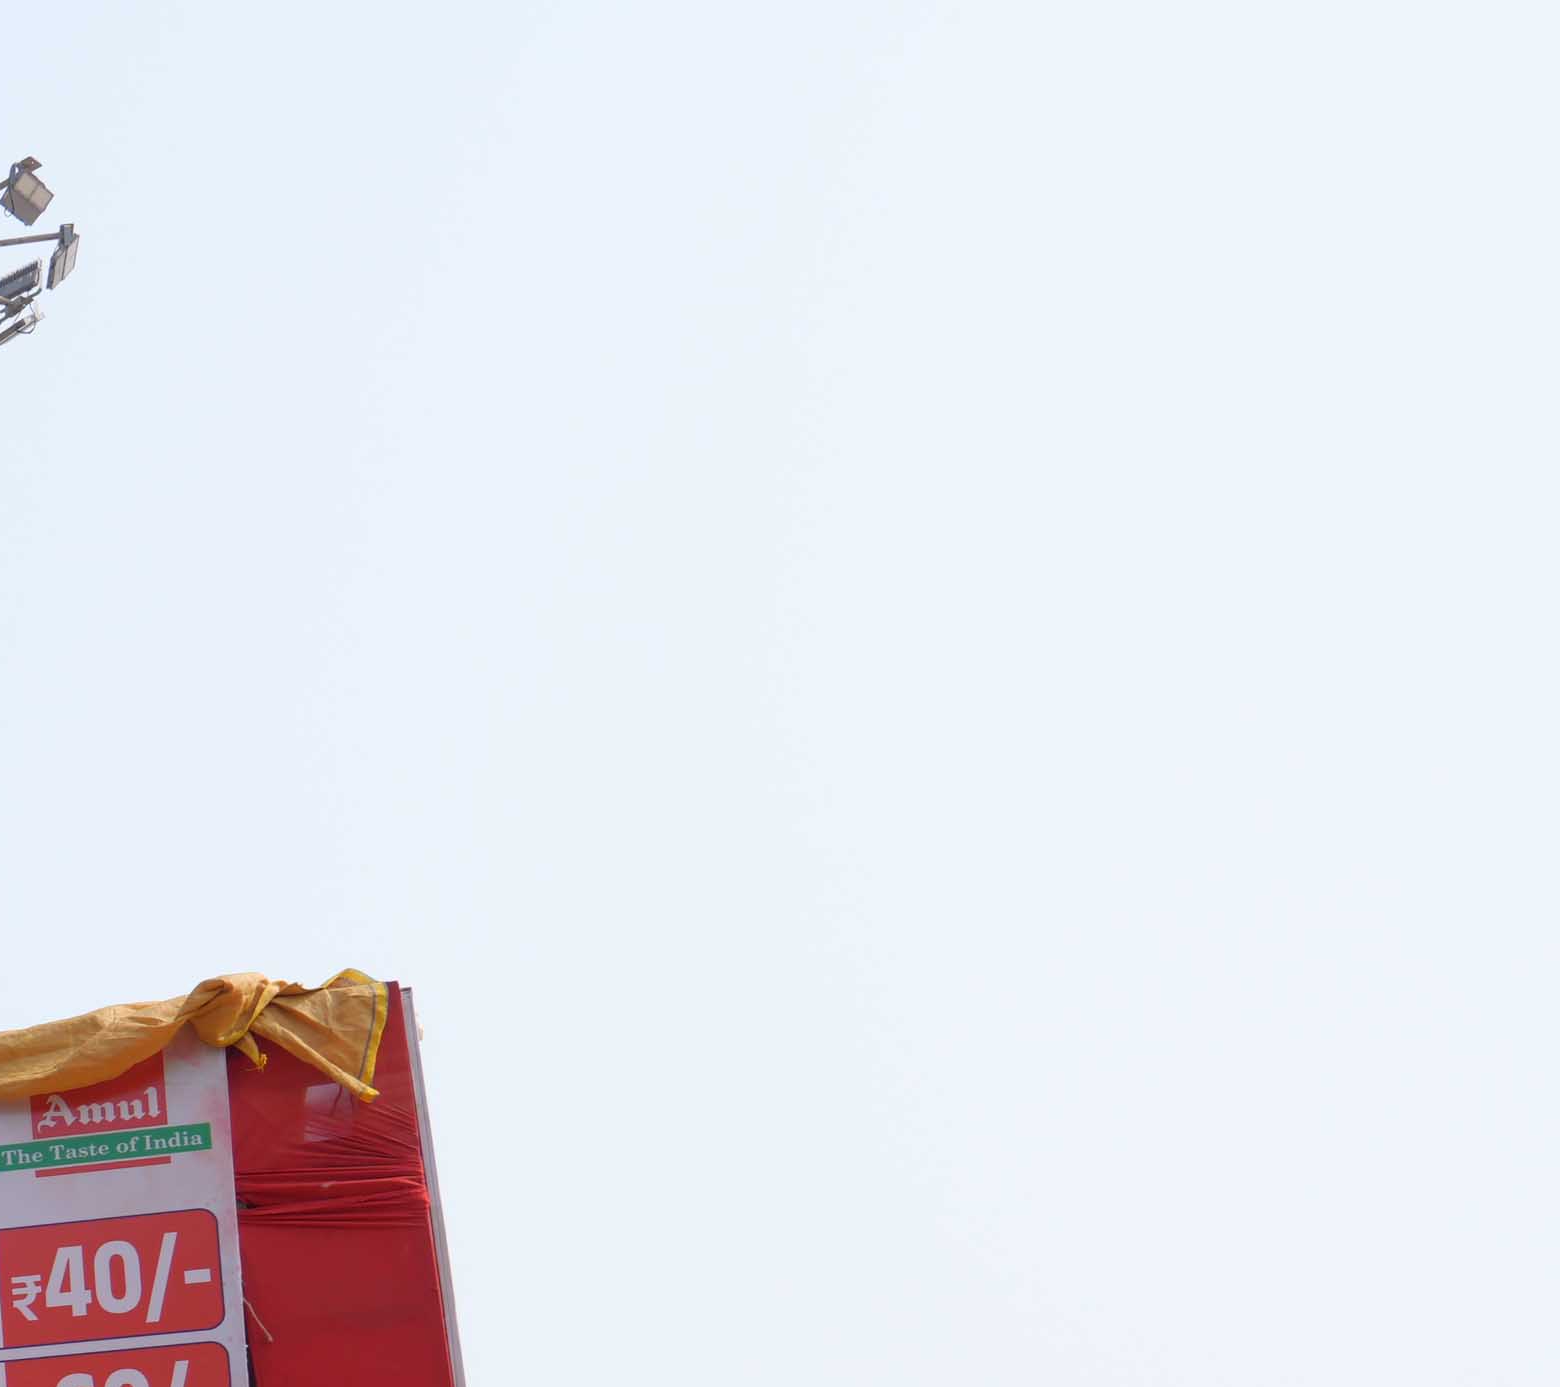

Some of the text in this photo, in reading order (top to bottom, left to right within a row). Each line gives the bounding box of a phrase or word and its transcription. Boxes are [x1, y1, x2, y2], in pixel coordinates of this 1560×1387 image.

[1, 1129, 204, 1167] The Taste of India
[11, 1231, 212, 1322] ₹40/-
